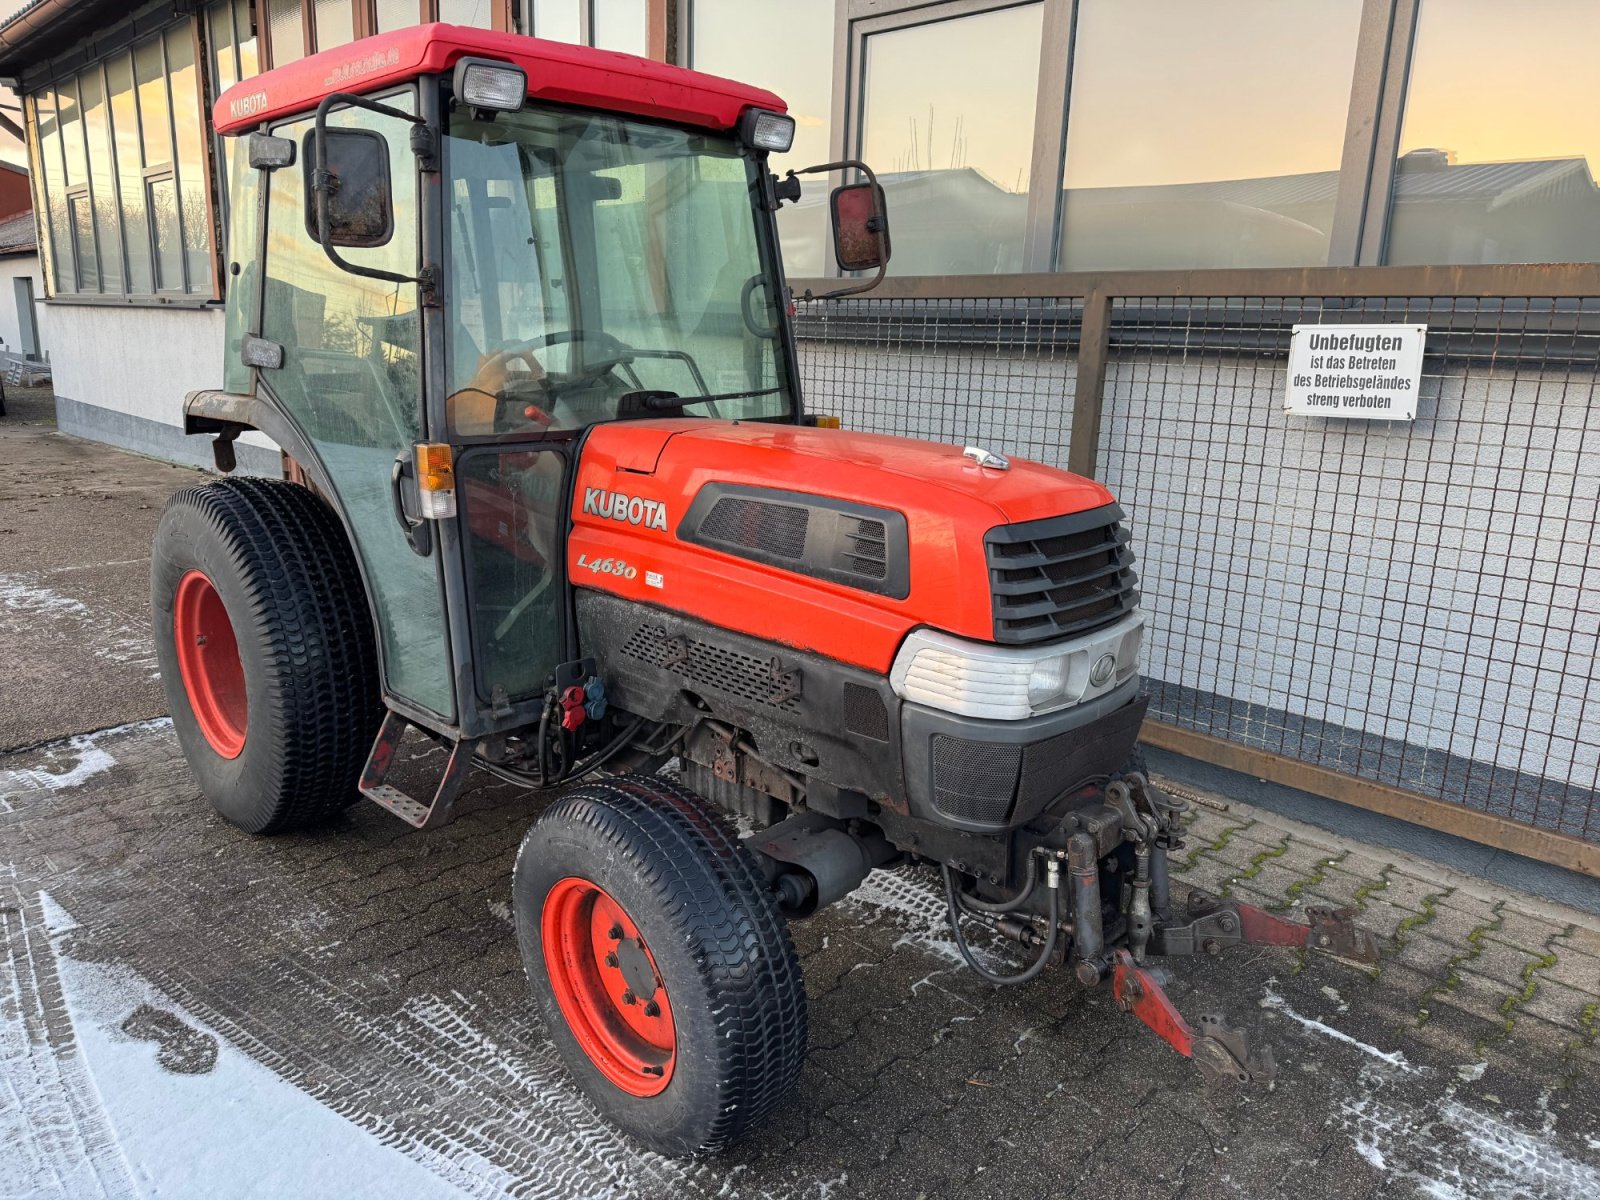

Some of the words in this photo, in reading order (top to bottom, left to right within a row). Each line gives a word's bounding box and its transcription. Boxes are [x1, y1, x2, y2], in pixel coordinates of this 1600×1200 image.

[230, 90, 267, 118] KUBOTA
[1309, 333, 1403, 353] Unbefugten
[1310, 355, 1324, 369] ist
[1326, 355, 1345, 370] das
[1348, 355, 1396, 370] Betreten
[1293, 373, 1312, 387] des
[1314, 374, 1411, 391] Betriebsgeländes
[1306, 393, 1340, 408] streng
[1342, 394, 1391, 409] verboten
[583, 486, 668, 532] KUBOTA
[576, 553, 637, 580] L4630
